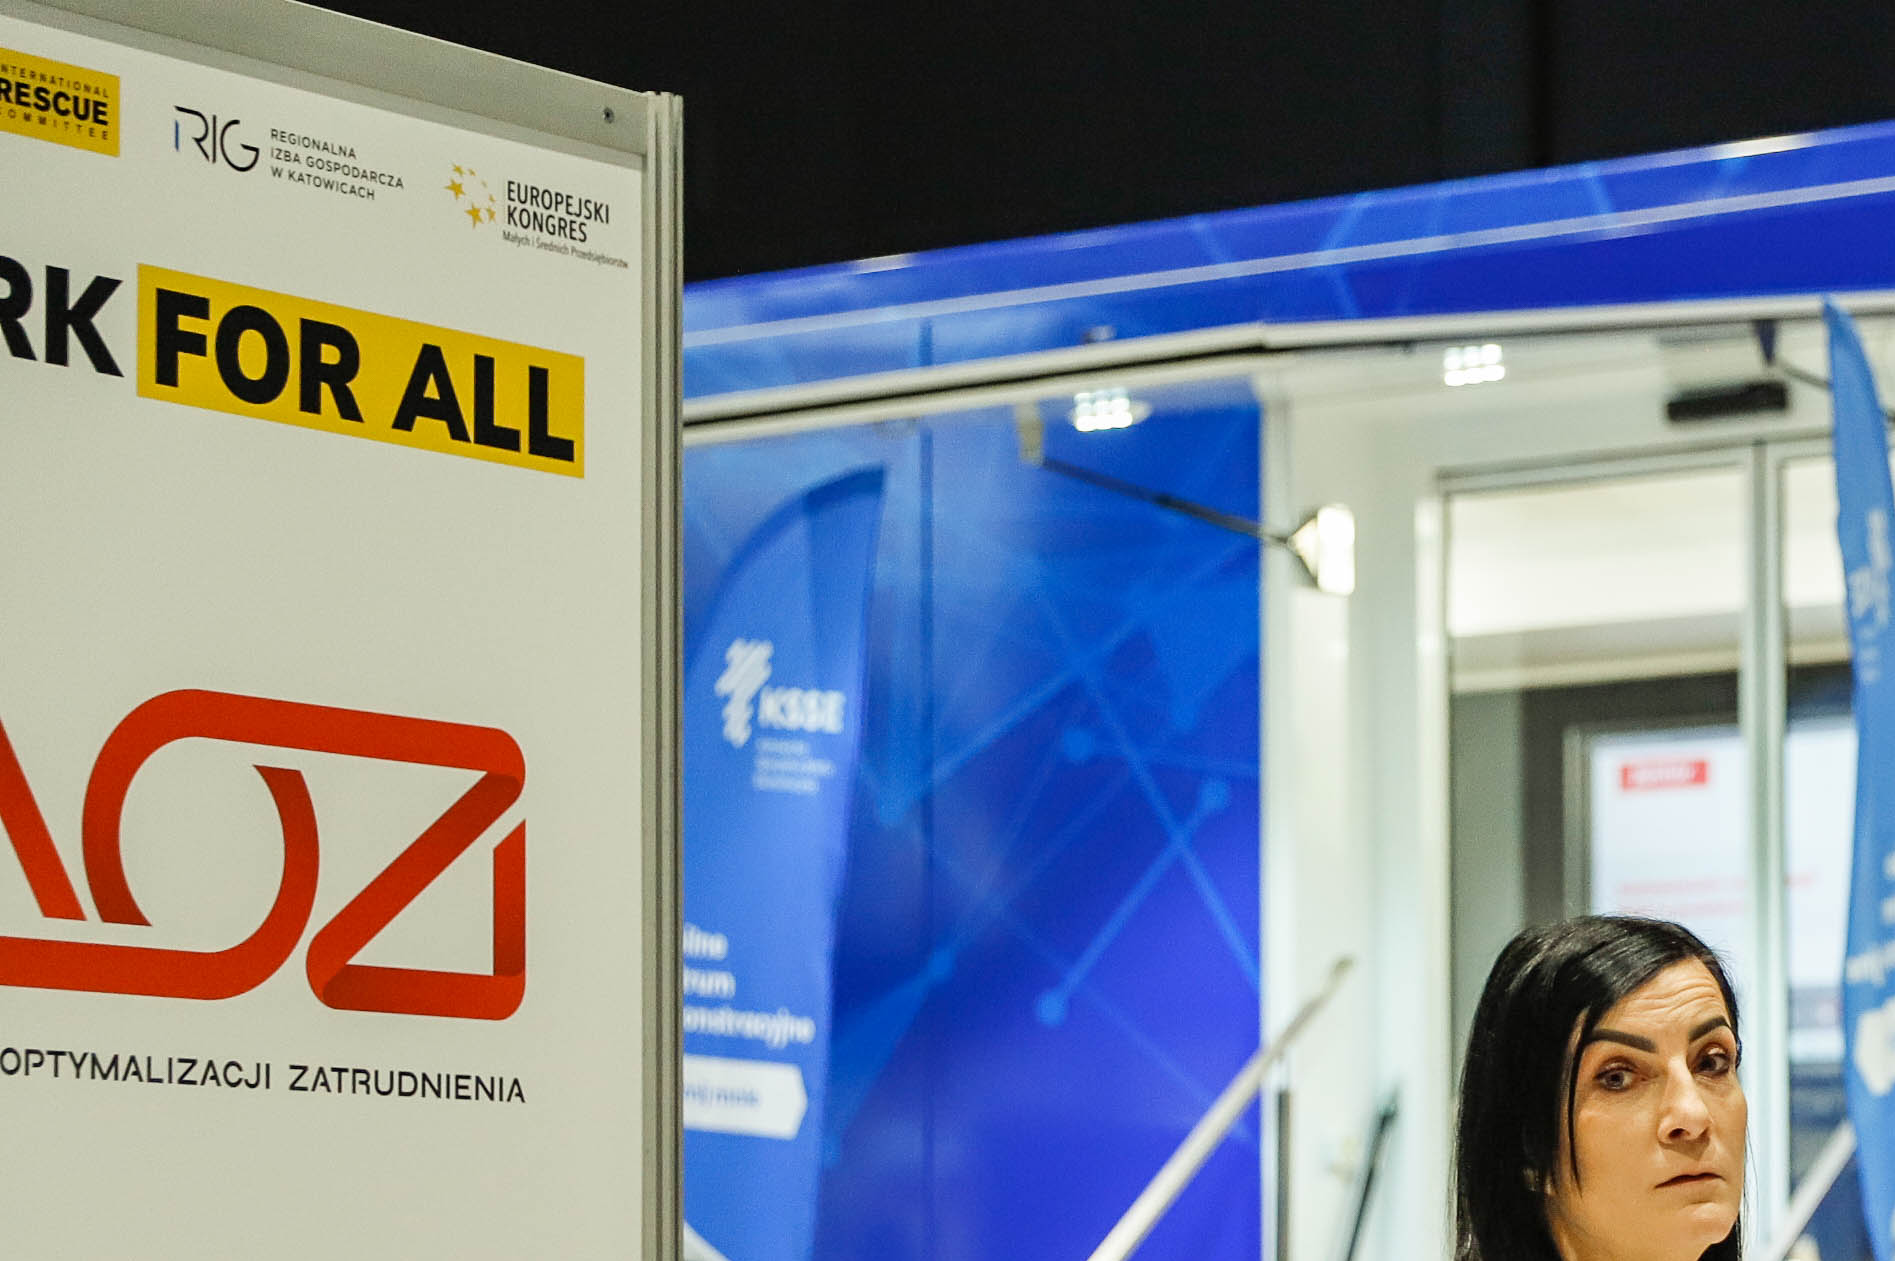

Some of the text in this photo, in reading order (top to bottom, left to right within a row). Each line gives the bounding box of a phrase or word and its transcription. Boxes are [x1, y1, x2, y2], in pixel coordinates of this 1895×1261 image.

[0, 77, 108, 126] RESCUE
[0, 107, 108, 141] OMMITTEE
[174, 104, 260, 172] RIG
[270, 128, 357, 160] REGIONALNA
[270, 147, 405, 189] IZBA GOSPODARCZA
[270, 165, 375, 200] W KATOWICACH
[507, 180, 609, 224] EUROPEJSKI
[507, 205, 588, 243] KONGRES
[155, 286, 364, 424] FOR
[391, 342, 575, 463] ALL
[0, 1047, 526, 1102] OPTYMALIZACJI ZATRUDNIENIA
